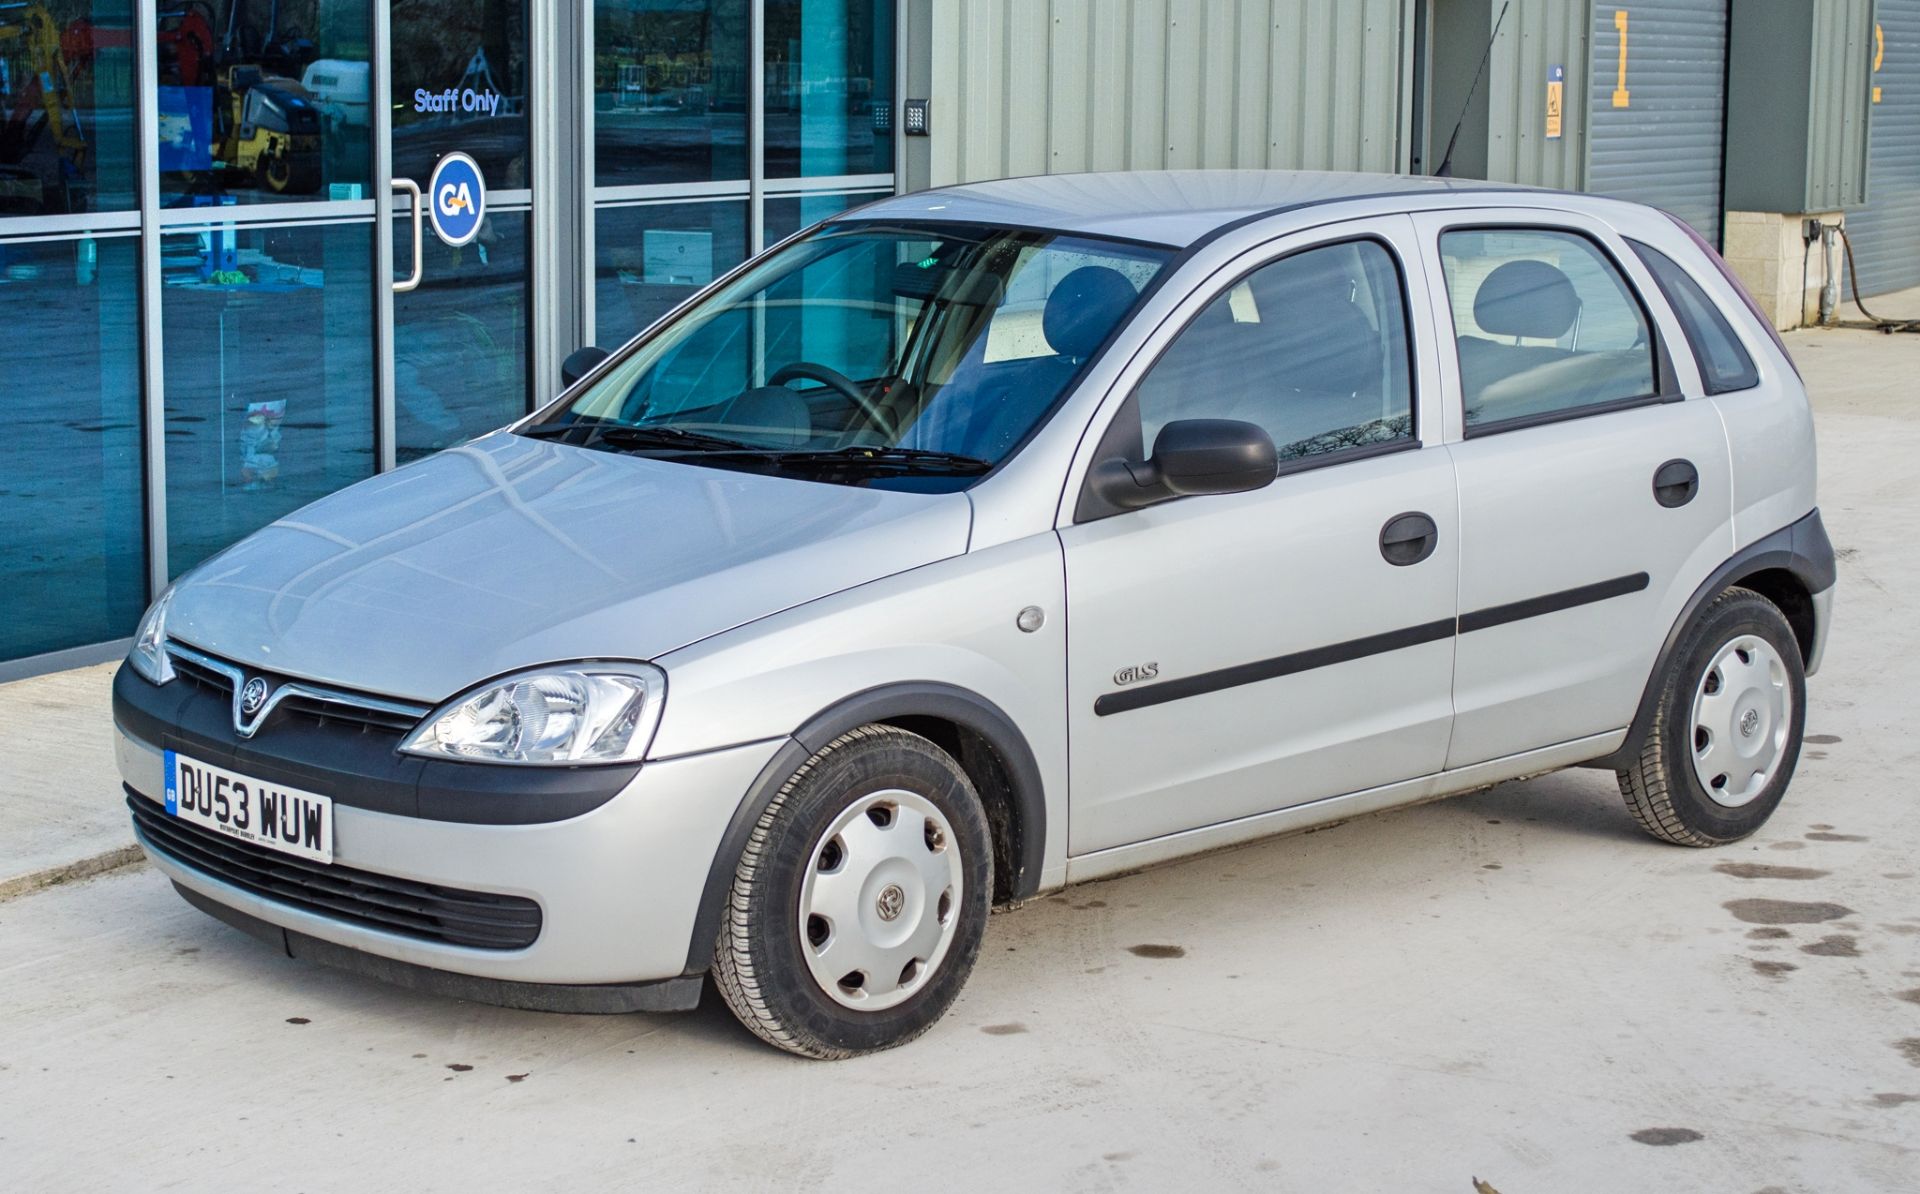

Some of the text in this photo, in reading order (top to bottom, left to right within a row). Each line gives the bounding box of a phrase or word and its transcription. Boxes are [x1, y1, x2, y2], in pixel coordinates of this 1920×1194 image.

[1613, 10, 1629, 107] 1
[414, 88, 499, 116] Staff Only
[439, 182, 475, 216] GA
[1113, 662, 1159, 686] GLS
[181, 763, 322, 850] DU53 WUW
